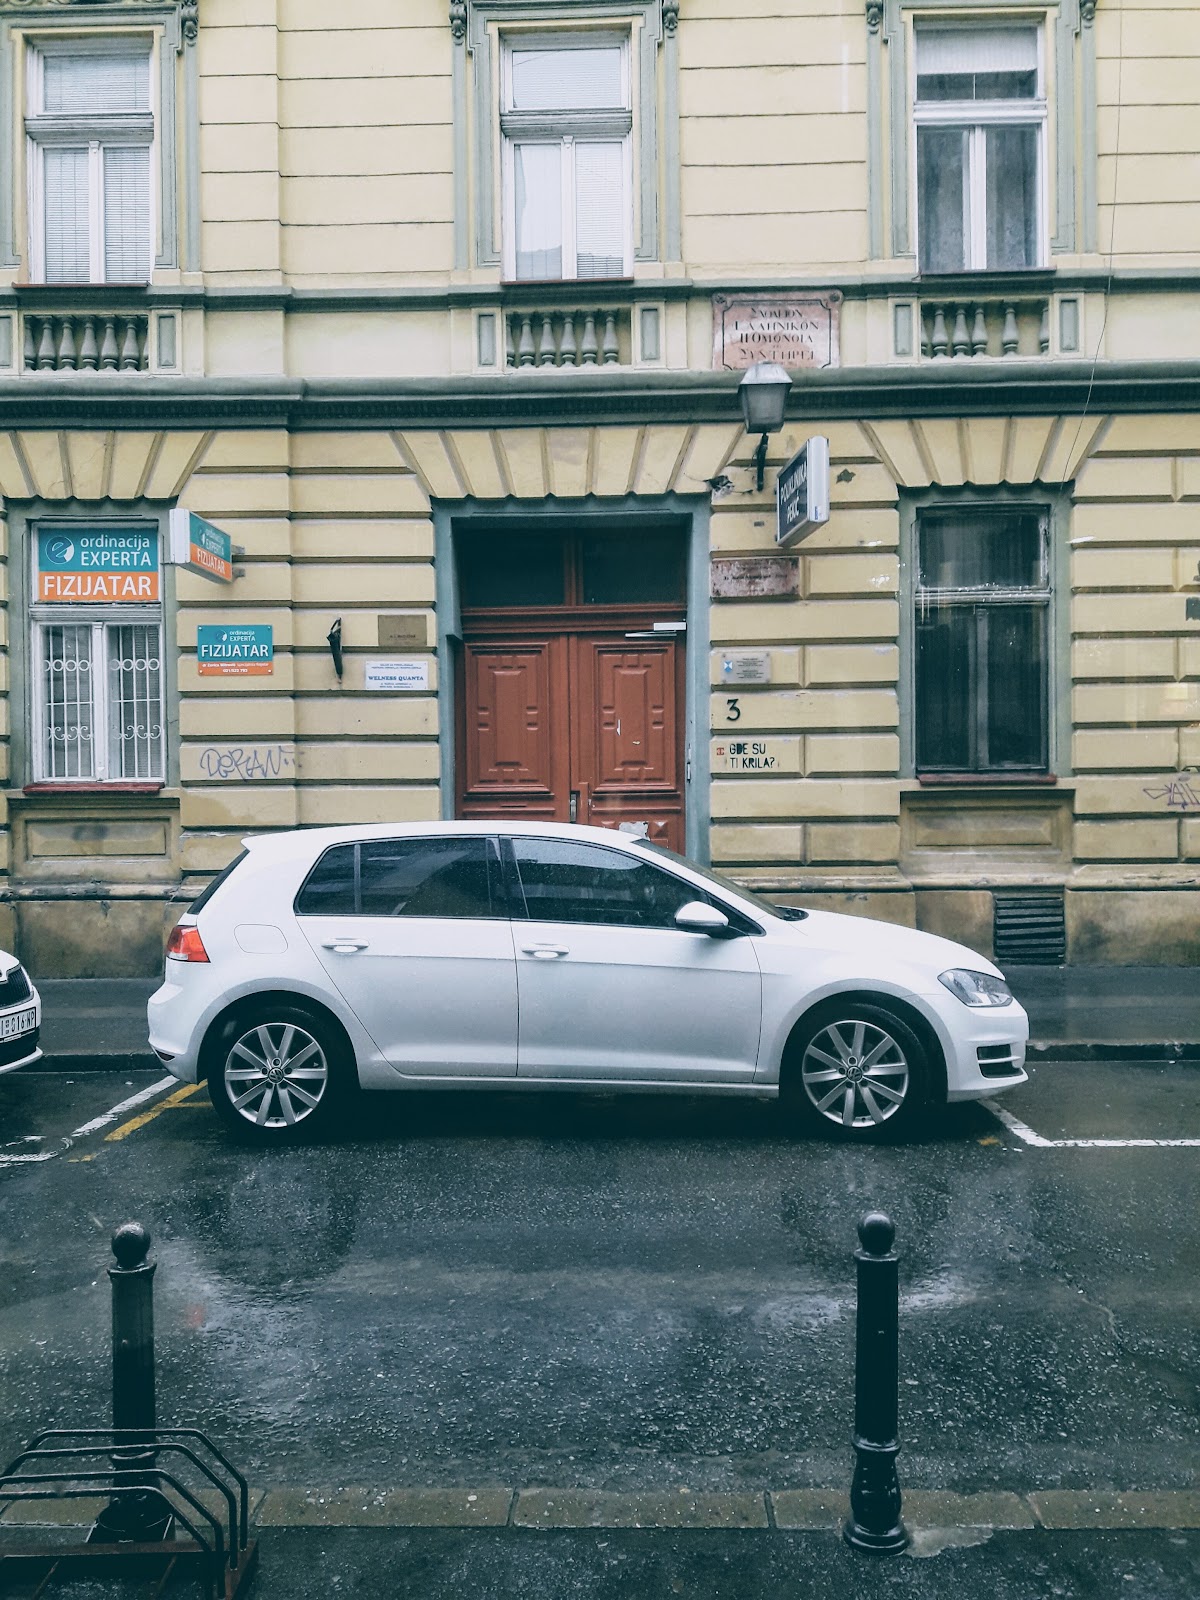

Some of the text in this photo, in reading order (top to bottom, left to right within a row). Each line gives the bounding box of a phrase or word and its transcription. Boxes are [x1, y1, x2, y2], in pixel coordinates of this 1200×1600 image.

[80, 534, 150, 551] ordinacija
[81, 551, 152, 566] EXPERTA
[196, 547, 226, 575] FIZIJATAR
[44, 575, 152, 596] FIZIJATAR
[229, 630, 256, 638] ordinacija
[201, 644, 269, 657] FIZIJATAR
[726, 698, 741, 721] 3
[729, 742, 766, 755] GDE SU
[729, 757, 775, 768] TI KRILA?
